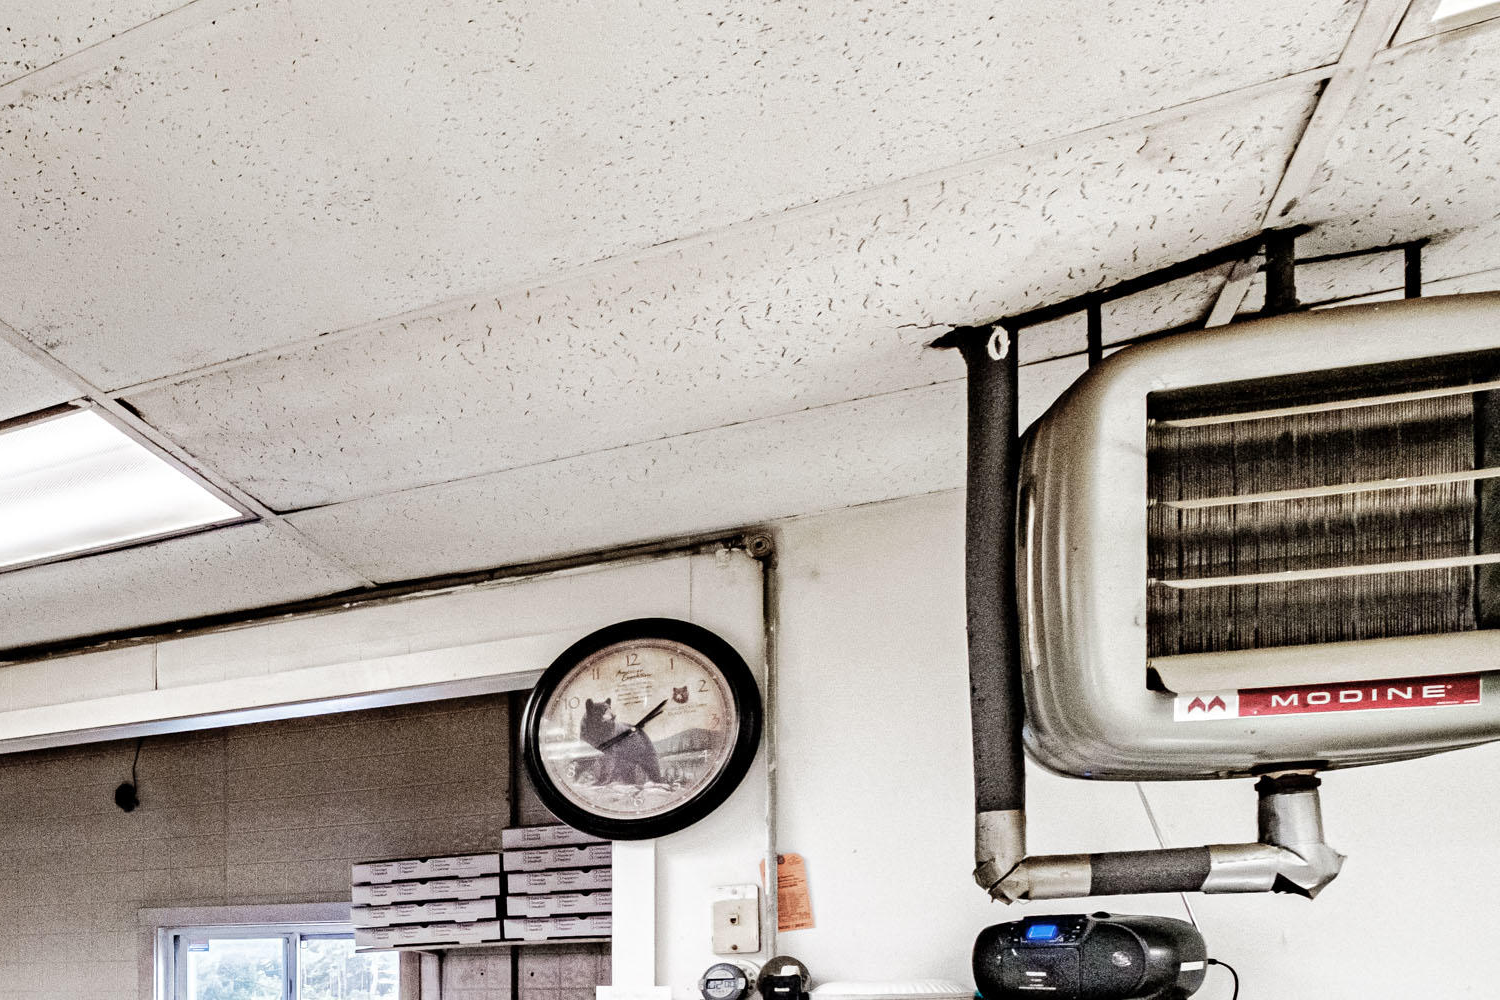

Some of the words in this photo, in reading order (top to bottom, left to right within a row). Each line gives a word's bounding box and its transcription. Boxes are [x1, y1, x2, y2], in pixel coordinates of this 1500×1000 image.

[626, 653, 641, 667] 12
[592, 667, 600, 680] 11
[698, 679, 709, 693] 2
[1271, 684, 1447, 707] MODINE
[564, 696, 580, 710] 10
[698, 749, 709, 762] 4
[566, 761, 578, 778] 8
